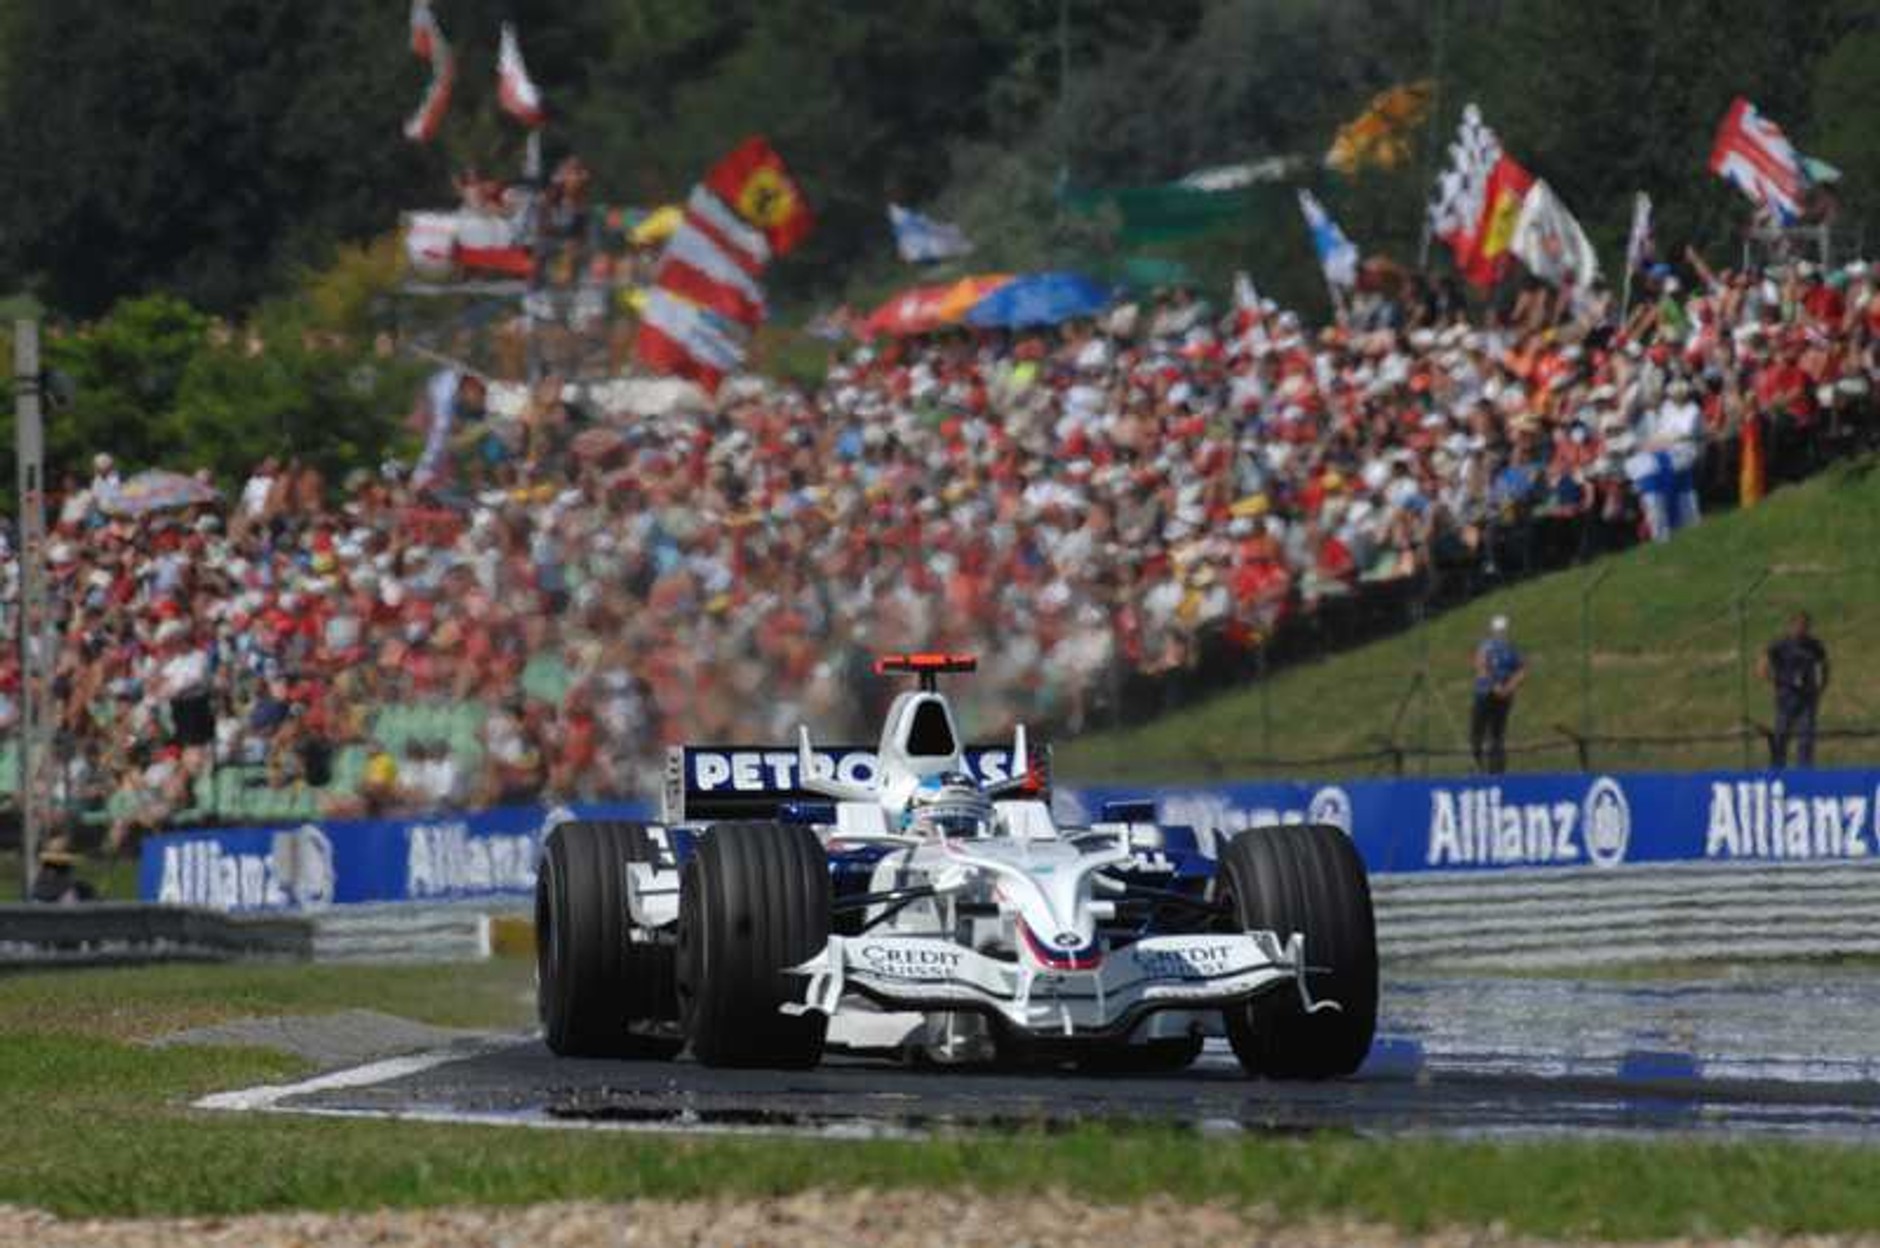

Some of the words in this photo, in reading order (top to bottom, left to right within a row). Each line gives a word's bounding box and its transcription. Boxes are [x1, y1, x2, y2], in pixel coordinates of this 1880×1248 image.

[696, 752, 1010, 791] PETROS
[1428, 787, 1578, 865] Allianz
[1706, 782, 1868, 857] Allianz
[862, 944, 961, 966] CREDIT
